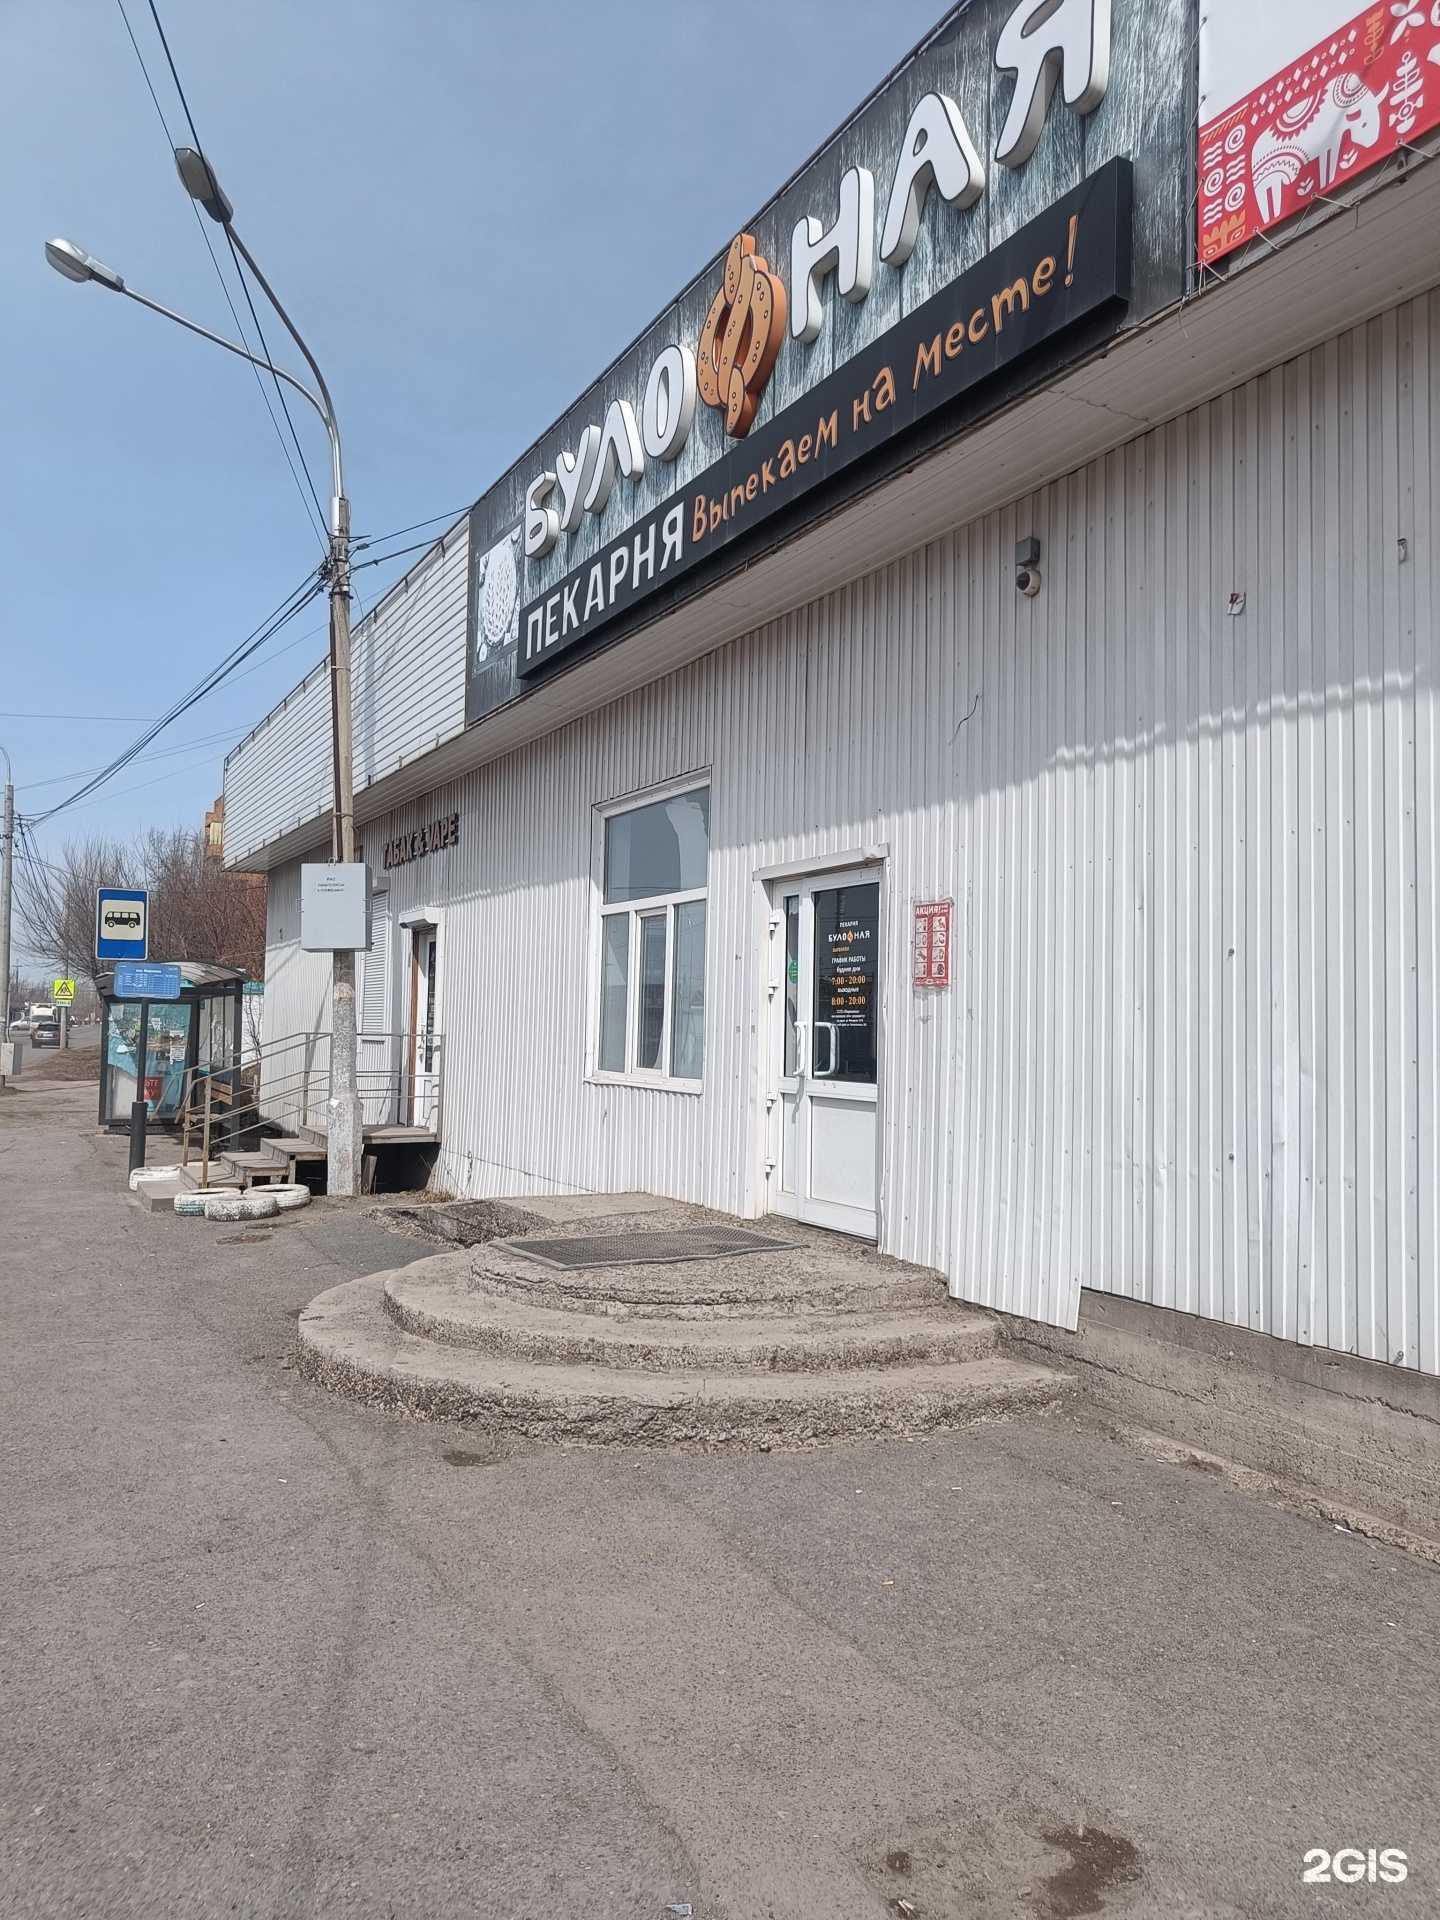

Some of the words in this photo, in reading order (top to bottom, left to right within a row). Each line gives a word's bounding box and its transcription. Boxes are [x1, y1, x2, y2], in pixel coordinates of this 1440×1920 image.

[526, 501, 685, 660] ПЕКАРНЯ
[692, 408, 839, 543] Выпекаем
[853, 366, 896, 432] на
[912, 214, 1078, 392] месте!
[848, 975, 866, 985] 20:00
[848, 995, 866, 1005] 20:00
